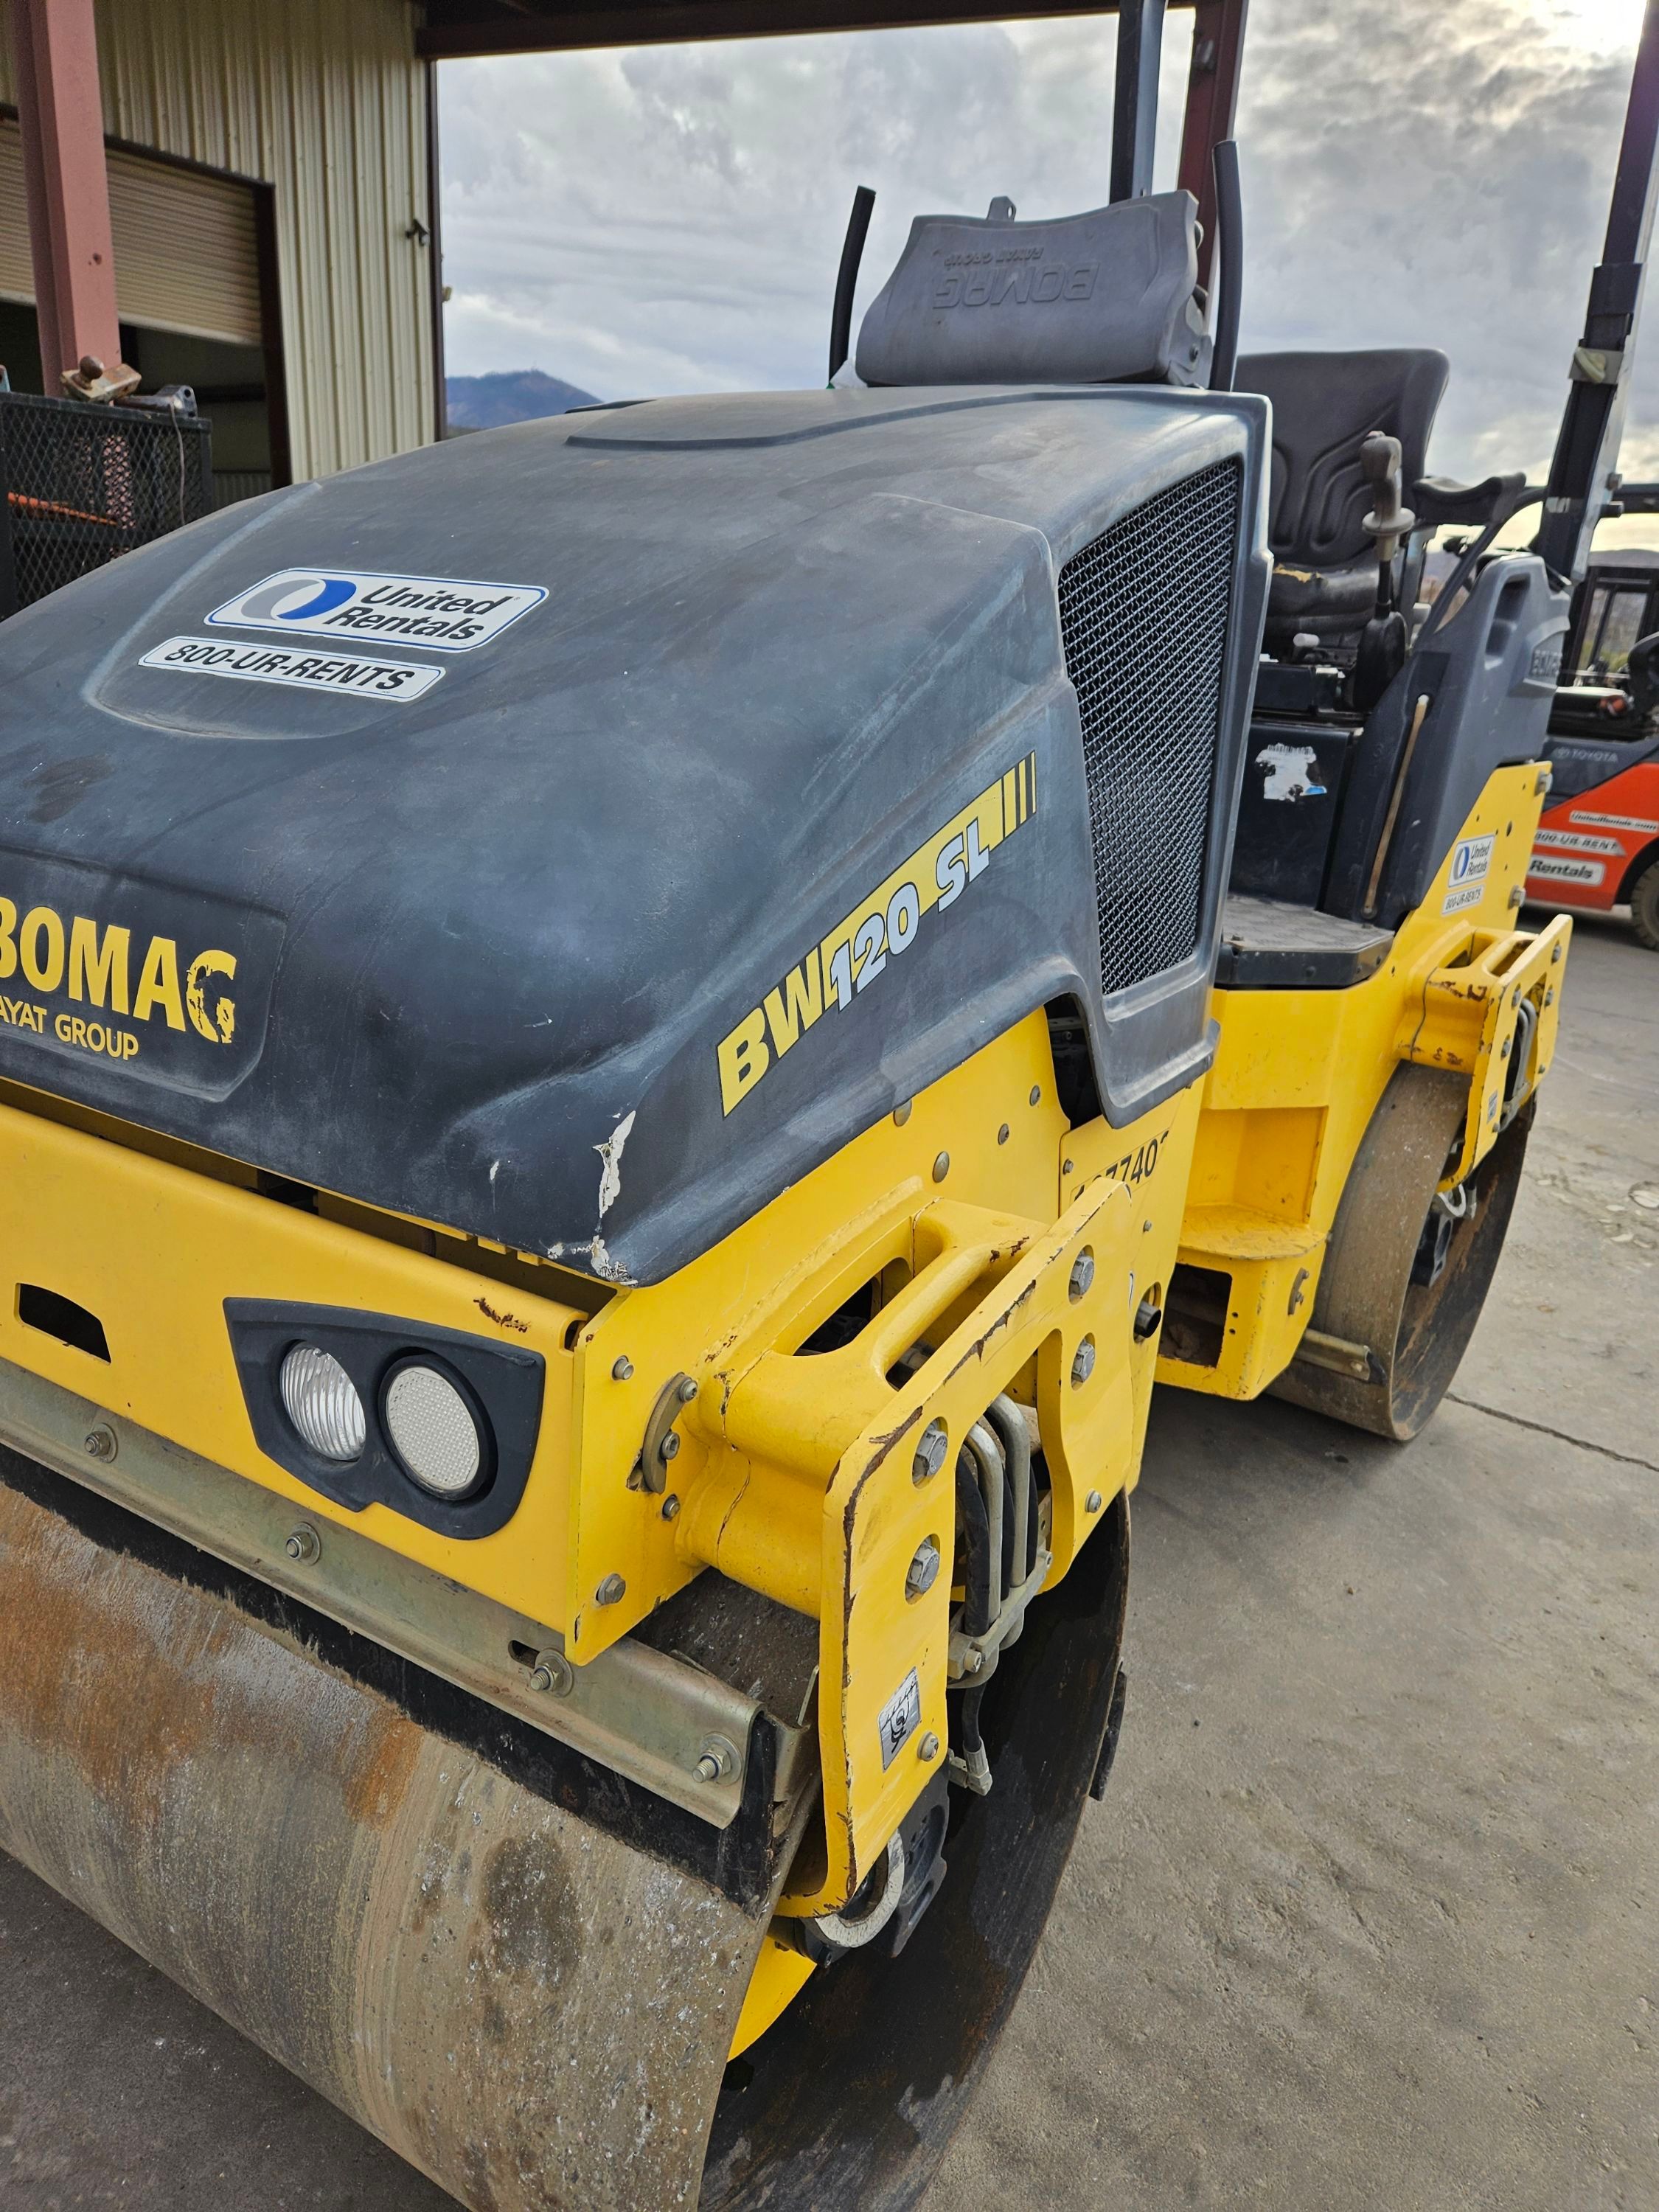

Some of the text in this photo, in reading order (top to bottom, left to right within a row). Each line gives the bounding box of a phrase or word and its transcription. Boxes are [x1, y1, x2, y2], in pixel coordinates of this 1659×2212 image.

[932, 259, 1100, 310] BOMAG
[361, 585, 512, 615] United
[321, 608, 484, 641] Rentals
[164, 644, 415, 690] 800-UR-RENTS
[1571, 748, 1618, 762] TOYOTA
[1471, 841, 1491, 859] United
[1466, 858, 1488, 877] Rentals
[1530, 859, 1593, 880] Rentals
[717, 817, 990, 1117] BW 120 SL
[55, 1013, 139, 1061] GROUP
